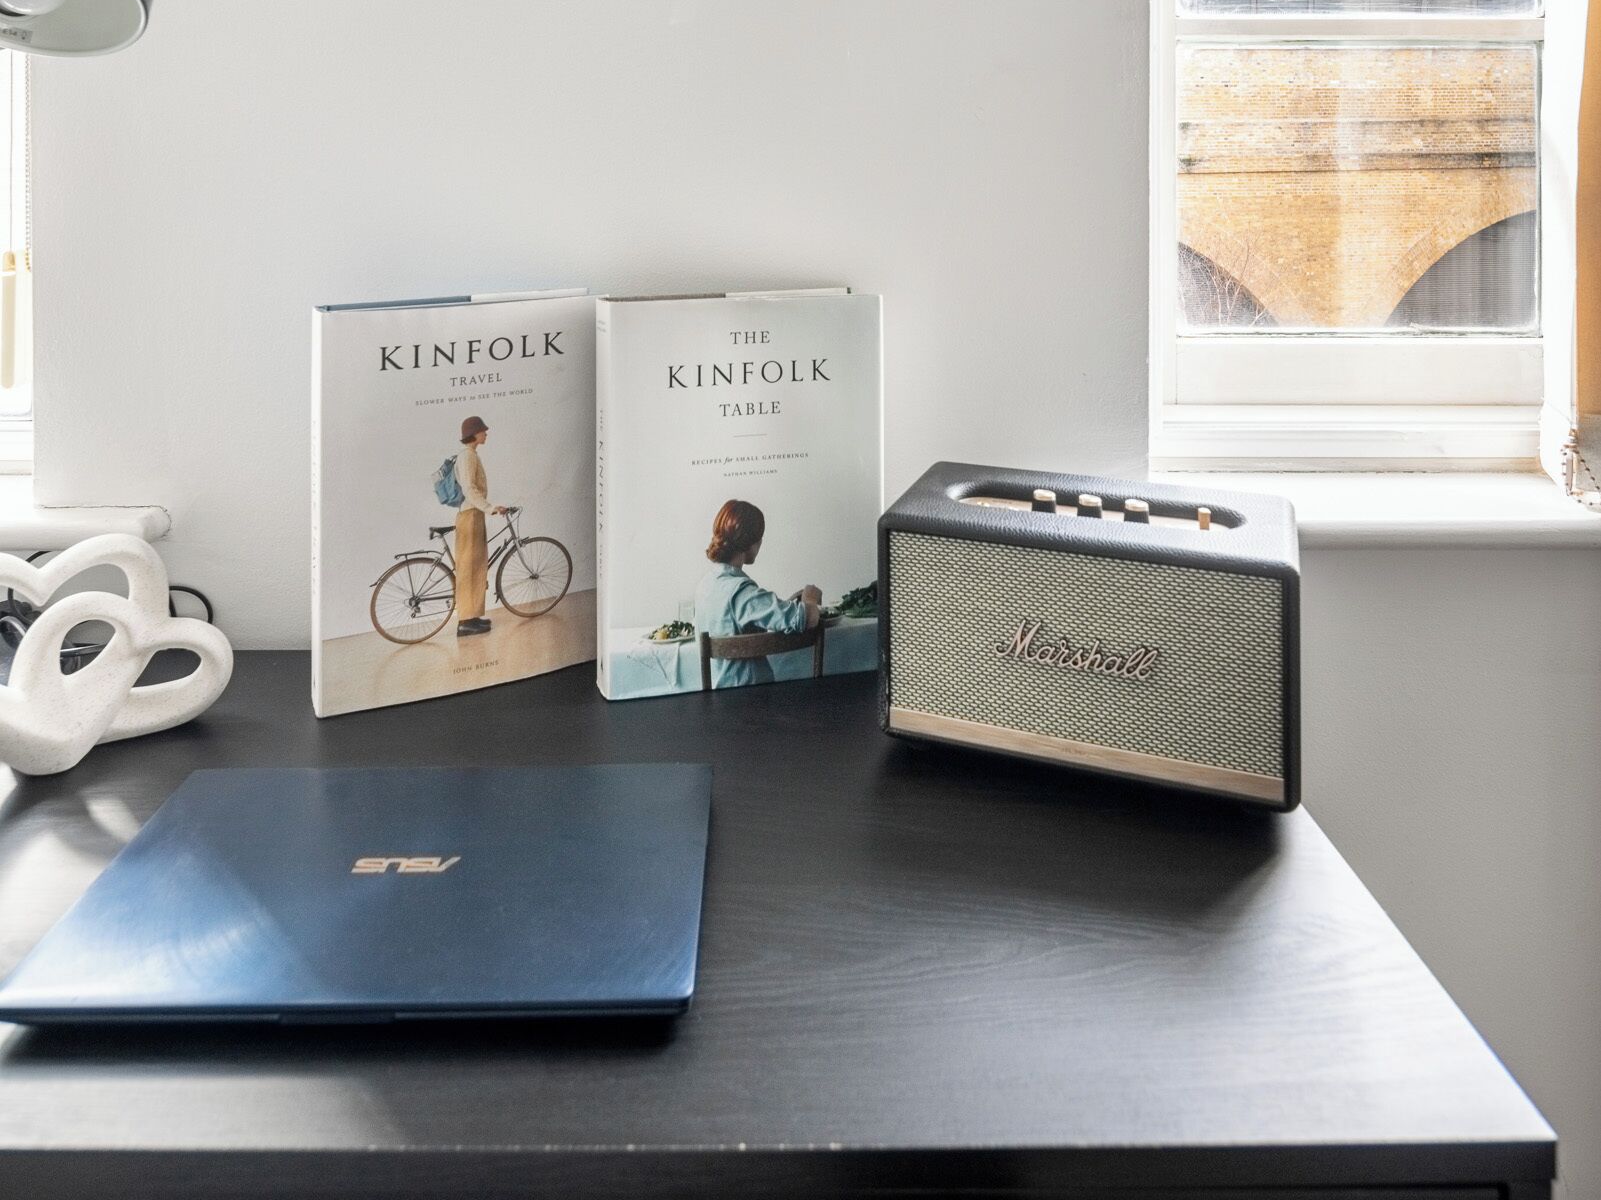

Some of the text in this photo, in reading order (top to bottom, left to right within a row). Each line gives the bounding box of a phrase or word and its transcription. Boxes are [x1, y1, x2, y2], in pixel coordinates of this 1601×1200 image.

[730, 330, 771, 345] THE
[379, 331, 565, 371] KINFOLK
[450, 372, 503, 387] TRAVEL
[668, 358, 831, 389] KINFOLK
[415, 397, 445, 406] SLOWER
[493, 390, 507, 398] THE
[509, 387, 534, 396] WORLD
[719, 401, 781, 417] TABLE
[691, 458, 722, 466] RECIPES
[723, 456, 734, 465] for
[761, 452, 809, 460] GATHERINGS
[994, 619, 1158, 679] Marshall
[475, 660, 499, 670] BURNS
[351, 856, 461, 874] ASUS
